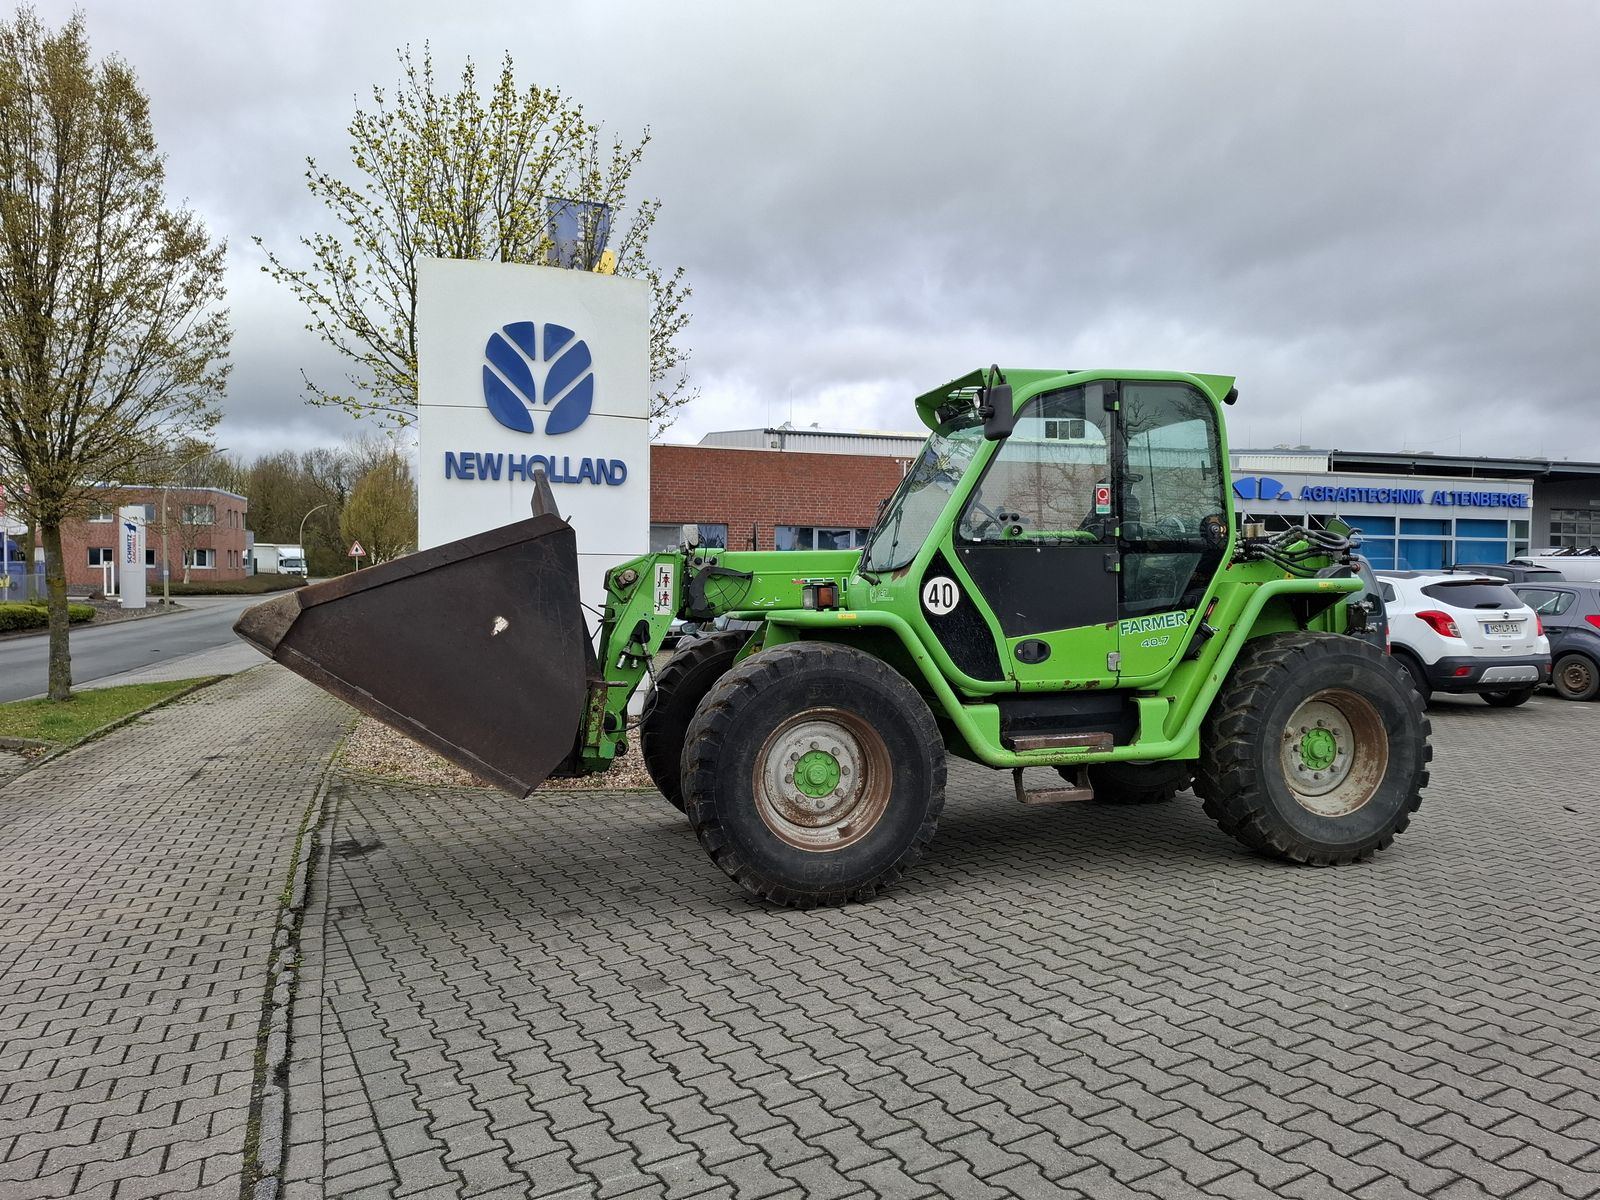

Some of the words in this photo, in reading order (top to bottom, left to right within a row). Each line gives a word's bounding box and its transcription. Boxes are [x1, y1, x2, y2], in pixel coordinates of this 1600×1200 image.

[445, 451, 503, 481] NEW
[508, 453, 628, 486] HOLLAND
[1301, 486, 1425, 504] AGRARTECHNIK
[1431, 490, 1529, 508] ALTENBERGE
[928, 583, 954, 608] 40
[1120, 612, 1188, 635] FARMER
[1141, 636, 1169, 647] 40.7
